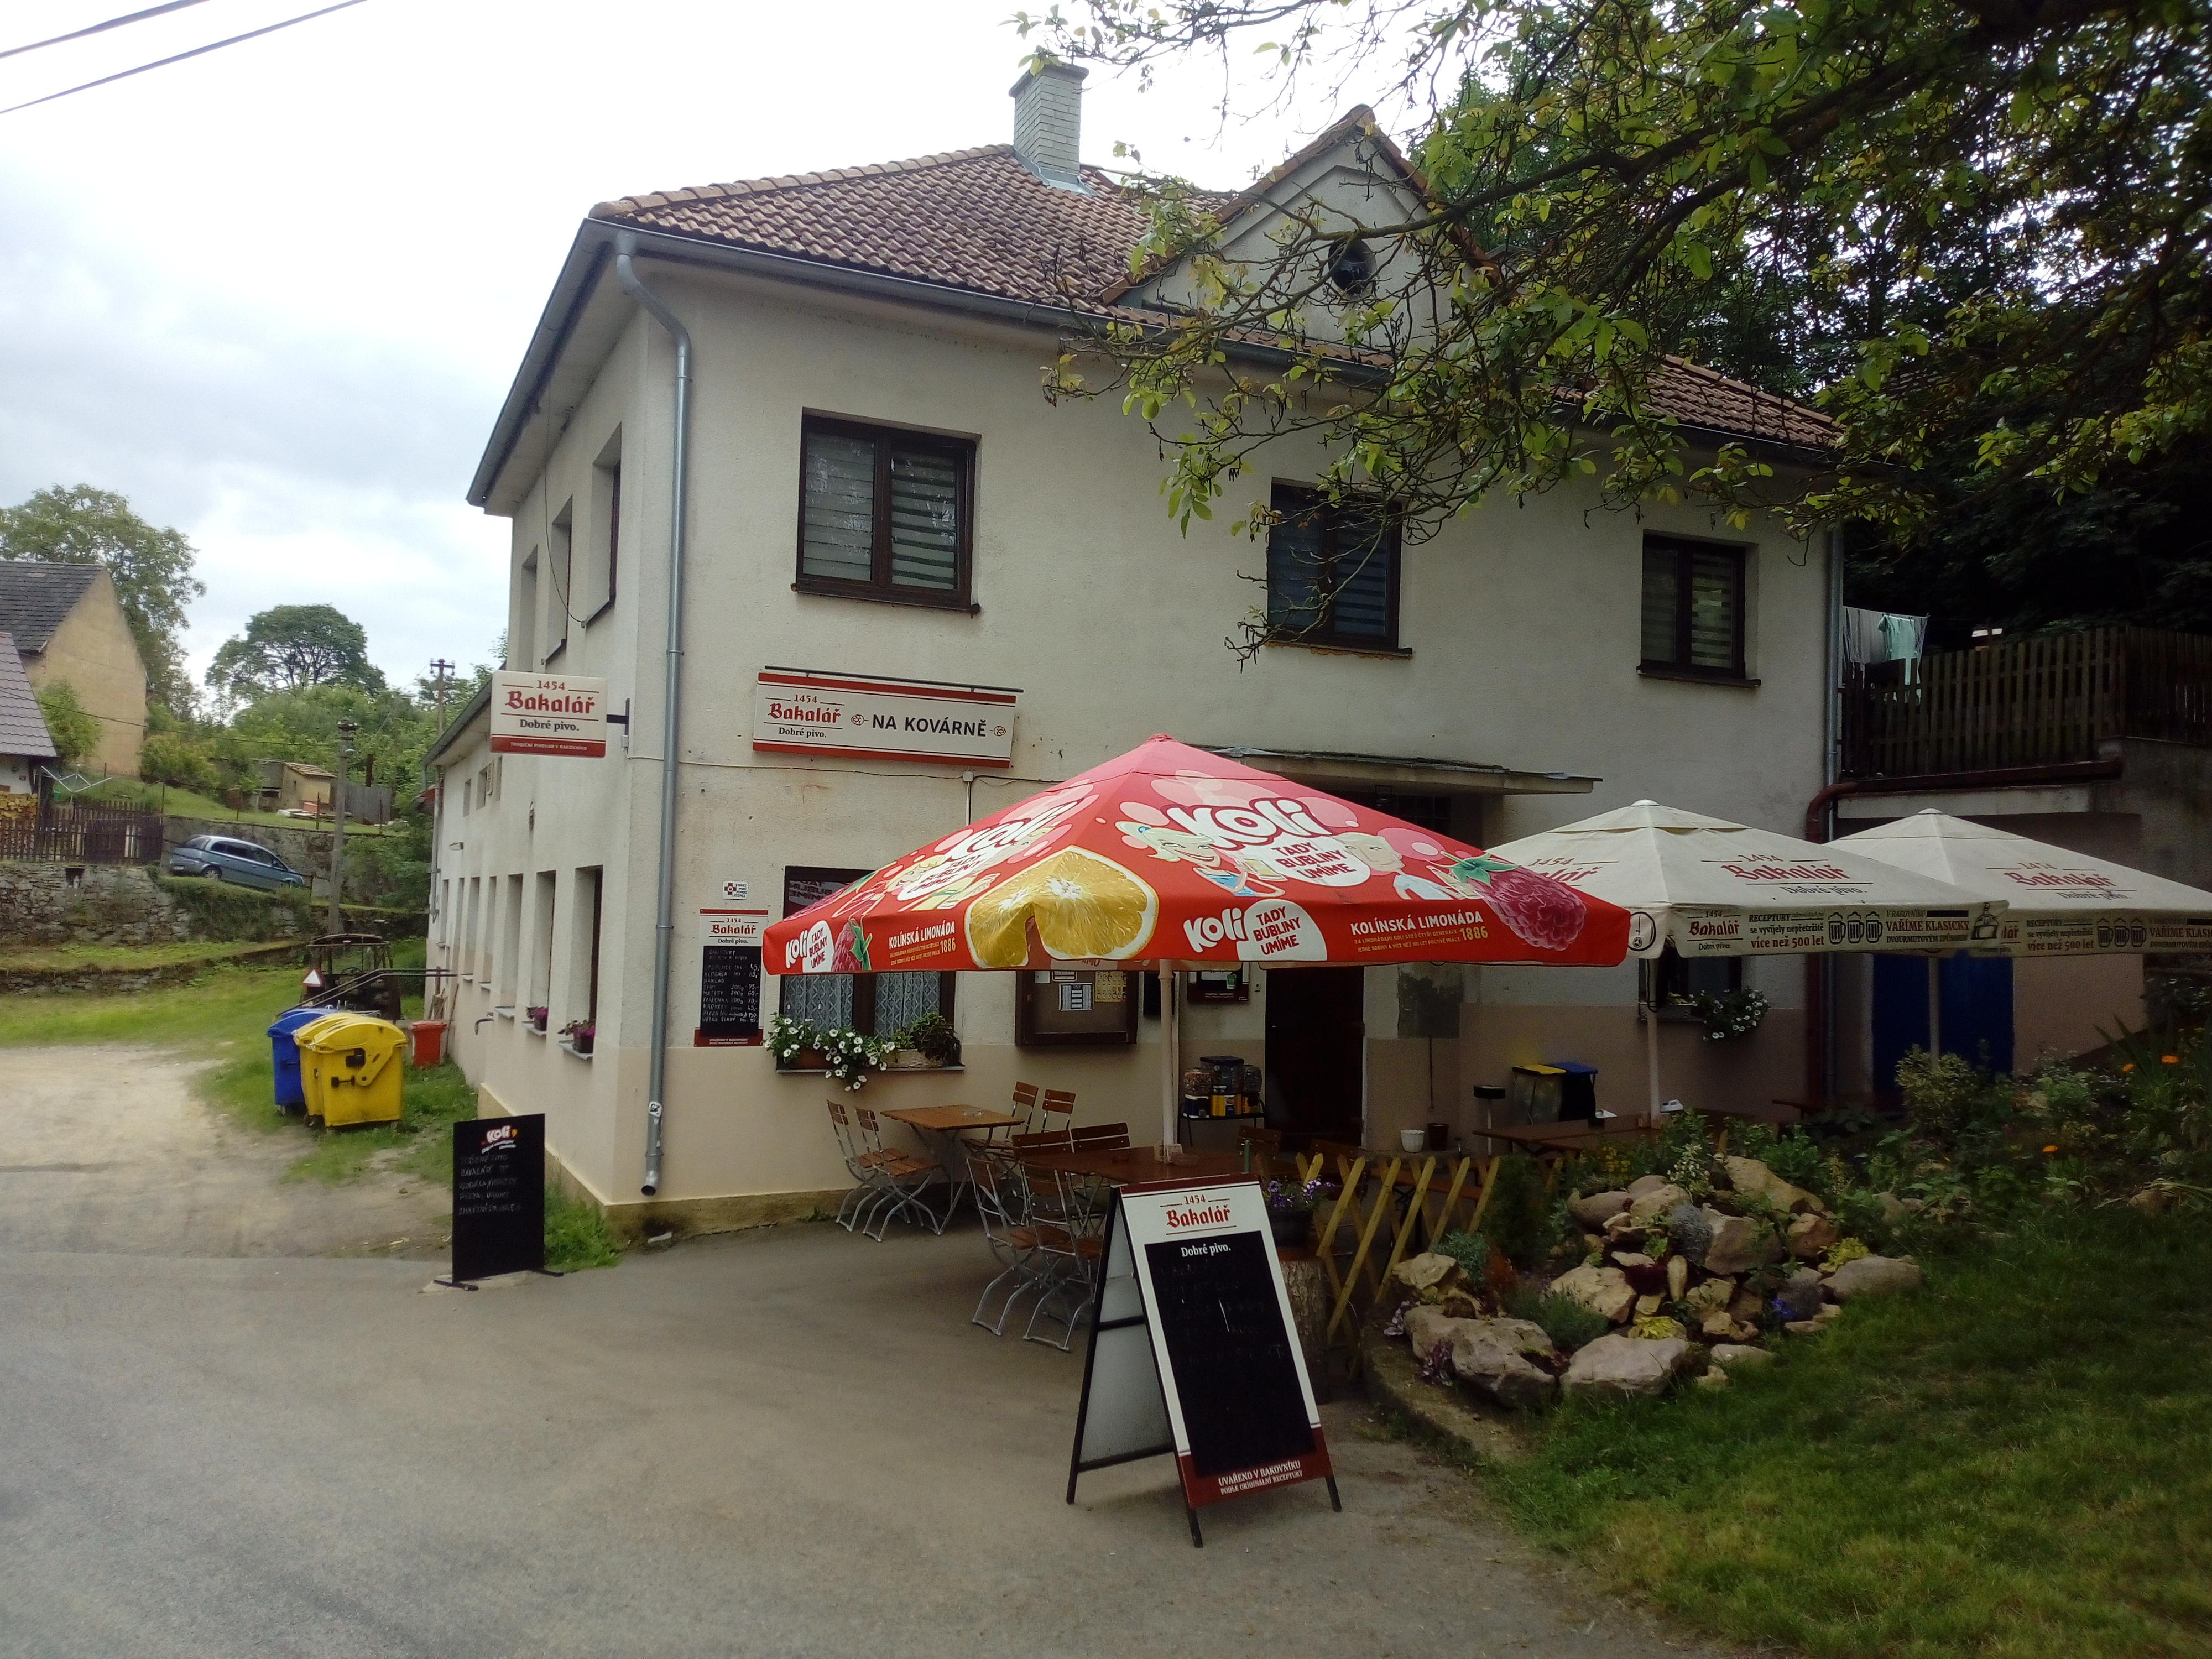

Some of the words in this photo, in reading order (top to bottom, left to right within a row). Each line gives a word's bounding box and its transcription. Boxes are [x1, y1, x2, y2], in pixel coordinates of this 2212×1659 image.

[536, 680, 565, 690] 1454
[505, 691, 595, 714] Bakalář
[794, 694, 818, 704] 1454
[768, 702, 841, 724] Bakalář
[520, 719, 551, 729] Dobré
[554, 722, 580, 732] pivo.
[779, 727, 804, 737] Dobré
[806, 728, 827, 739] pivo.
[872, 714, 897, 731] NA
[904, 717, 987, 737] KOVÁRNĚ
[1271, 842, 1320, 857] TADY
[1274, 849, 1349, 868] BUBLINY
[1528, 858, 1575, 866] 1454
[1297, 863, 1357, 879] UMÍME
[1721, 864, 1850, 880] Bakalář
[1255, 906, 1286, 926] TADY
[1350, 914, 1416, 936] KOLÍNSKÁ
[1418, 909, 1484, 928] LIMONÁDA
[1749, 914, 1791, 922] RECEPTURY
[711, 924, 756, 935] Bakalář
[1252, 917, 1301, 942] BUBLINY
[1459, 925, 1489, 941] 1886
[1689, 920, 1740, 936] Bakalář
[1886, 919, 1923, 931] VAŘÍME
[1926, 920, 1969, 931] KLASICKY
[812, 927, 823, 943] TADY
[889, 926, 919, 950] KOLÍNSKÁ
[921, 920, 955, 941] LIMONÁDA
[1751, 937, 1770, 948] více
[1772, 936, 1789, 947] než
[1792, 937, 1810, 948] 500
[1813, 935, 1825, 946] let
[809, 935, 828, 957] BUBLINY
[940, 937, 956, 953] 1886
[1260, 935, 1300, 955] UMÍME
[811, 951, 826, 969] UMÍME
[1183, 1194, 1206, 1206] 1454
[1166, 1204, 1230, 1228] Bakalář
[1180, 1243, 1208, 1258] Dobré
[1209, 1242, 1232, 1256] pivo.
[1218, 1471, 1253, 1486] UVAŘENO
[1253, 1469, 1259, 1478] V
[1260, 1460, 1301, 1478] RAKOVNÍKU
[1220, 1485, 1239, 1495] PODLE
[1239, 1475, 1272, 1490] ORIGINÁLNÍ
[1272, 1469, 1303, 1483] RECEPTURY
